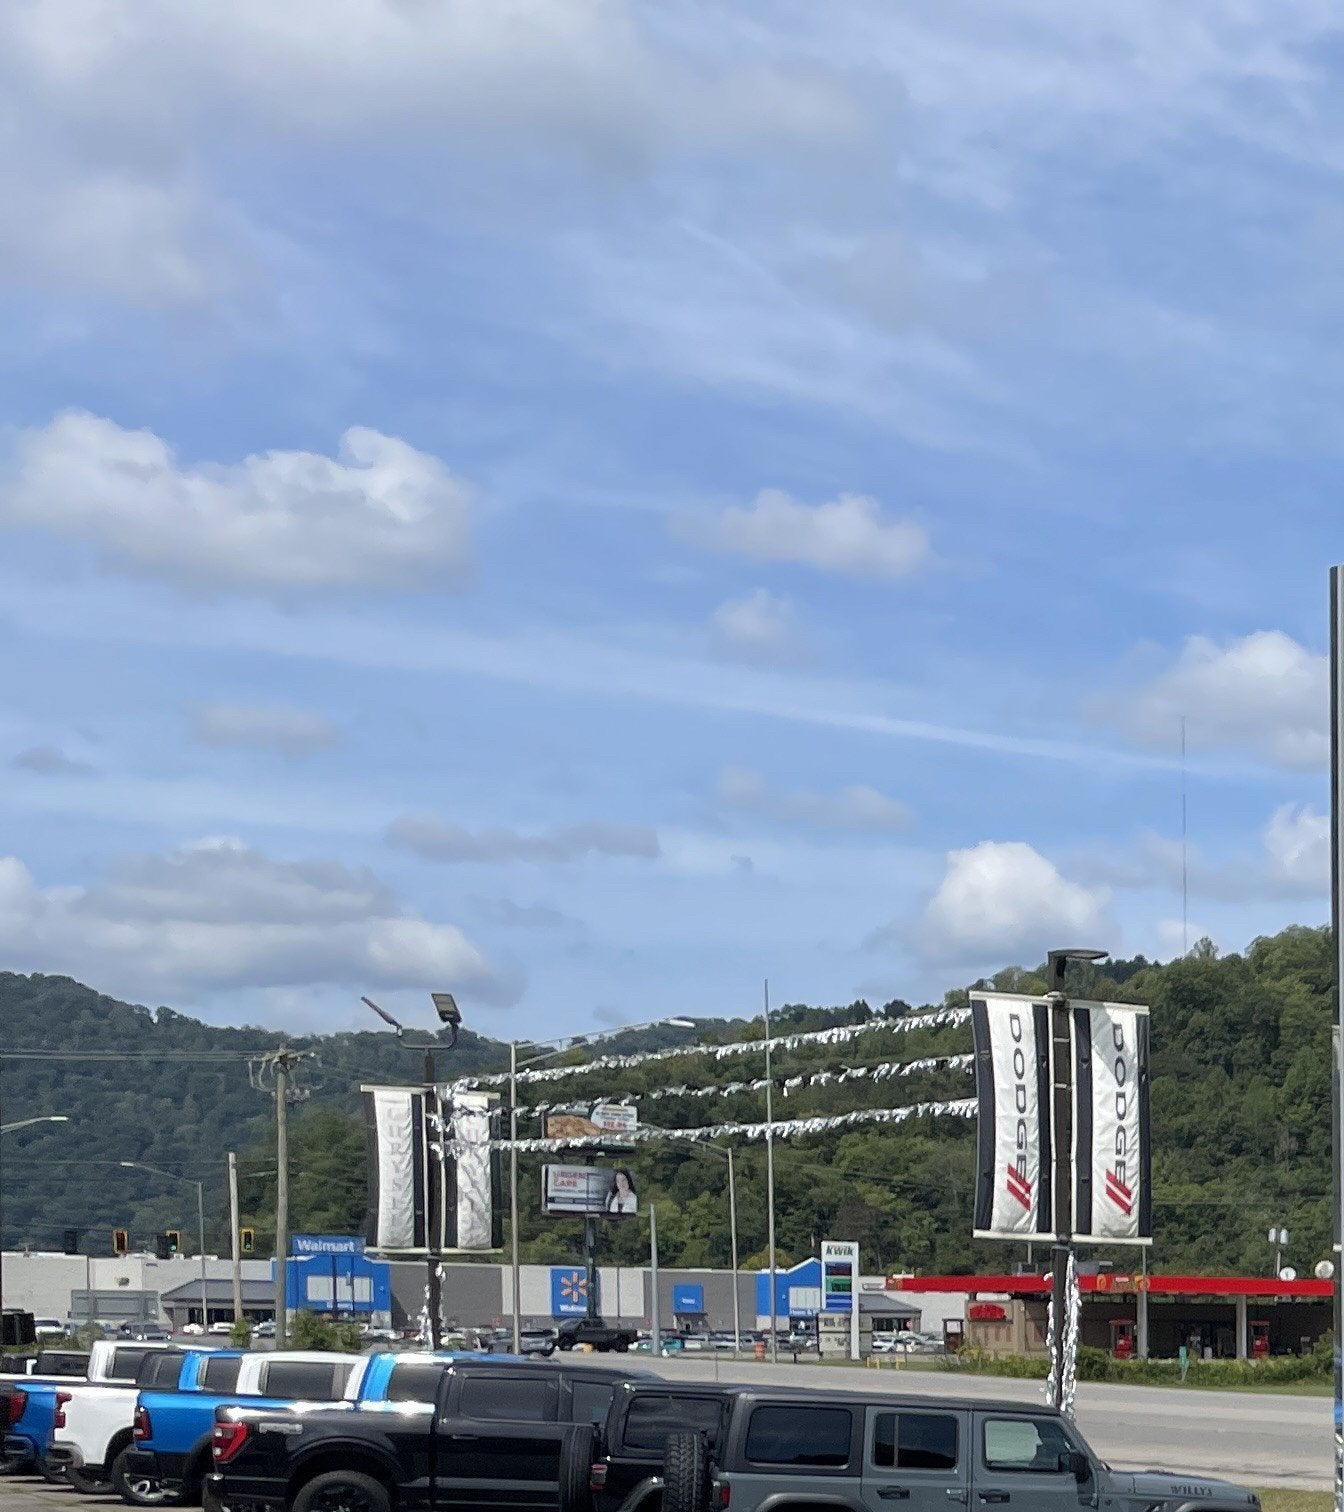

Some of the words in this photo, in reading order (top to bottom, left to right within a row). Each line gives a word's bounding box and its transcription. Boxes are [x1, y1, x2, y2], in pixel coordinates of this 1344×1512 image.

[1009, 1013, 1027, 1184] DODGE
[1112, 1023, 1127, 1187] DODGE
[297, 1239, 355, 1252] Walmart
[1170, 1485, 1213, 1497] WILLYS
